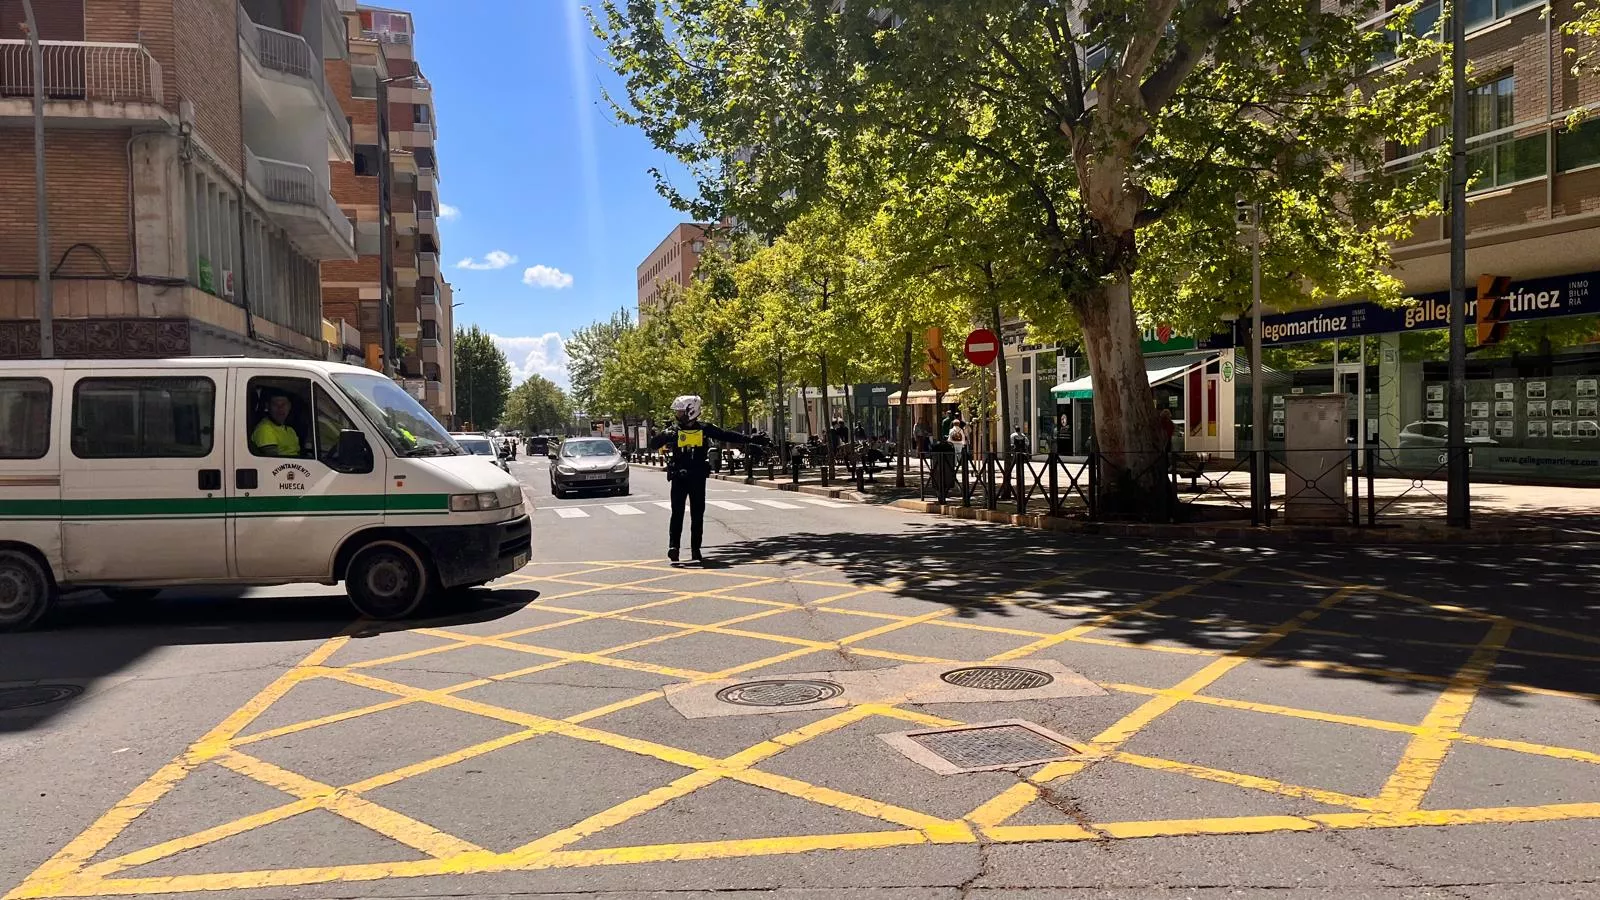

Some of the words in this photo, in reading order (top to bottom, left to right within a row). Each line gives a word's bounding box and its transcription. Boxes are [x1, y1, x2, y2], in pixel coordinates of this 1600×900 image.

[1568, 279, 1589, 289] INMO
[1568, 288, 1589, 298] BILIA
[1405, 287, 1560, 328] gálletínez
[1568, 297, 1582, 307] RIA
[1248, 313, 1347, 342] legomartínez
[272, 463, 311, 478] AYUNTAMIENTO
